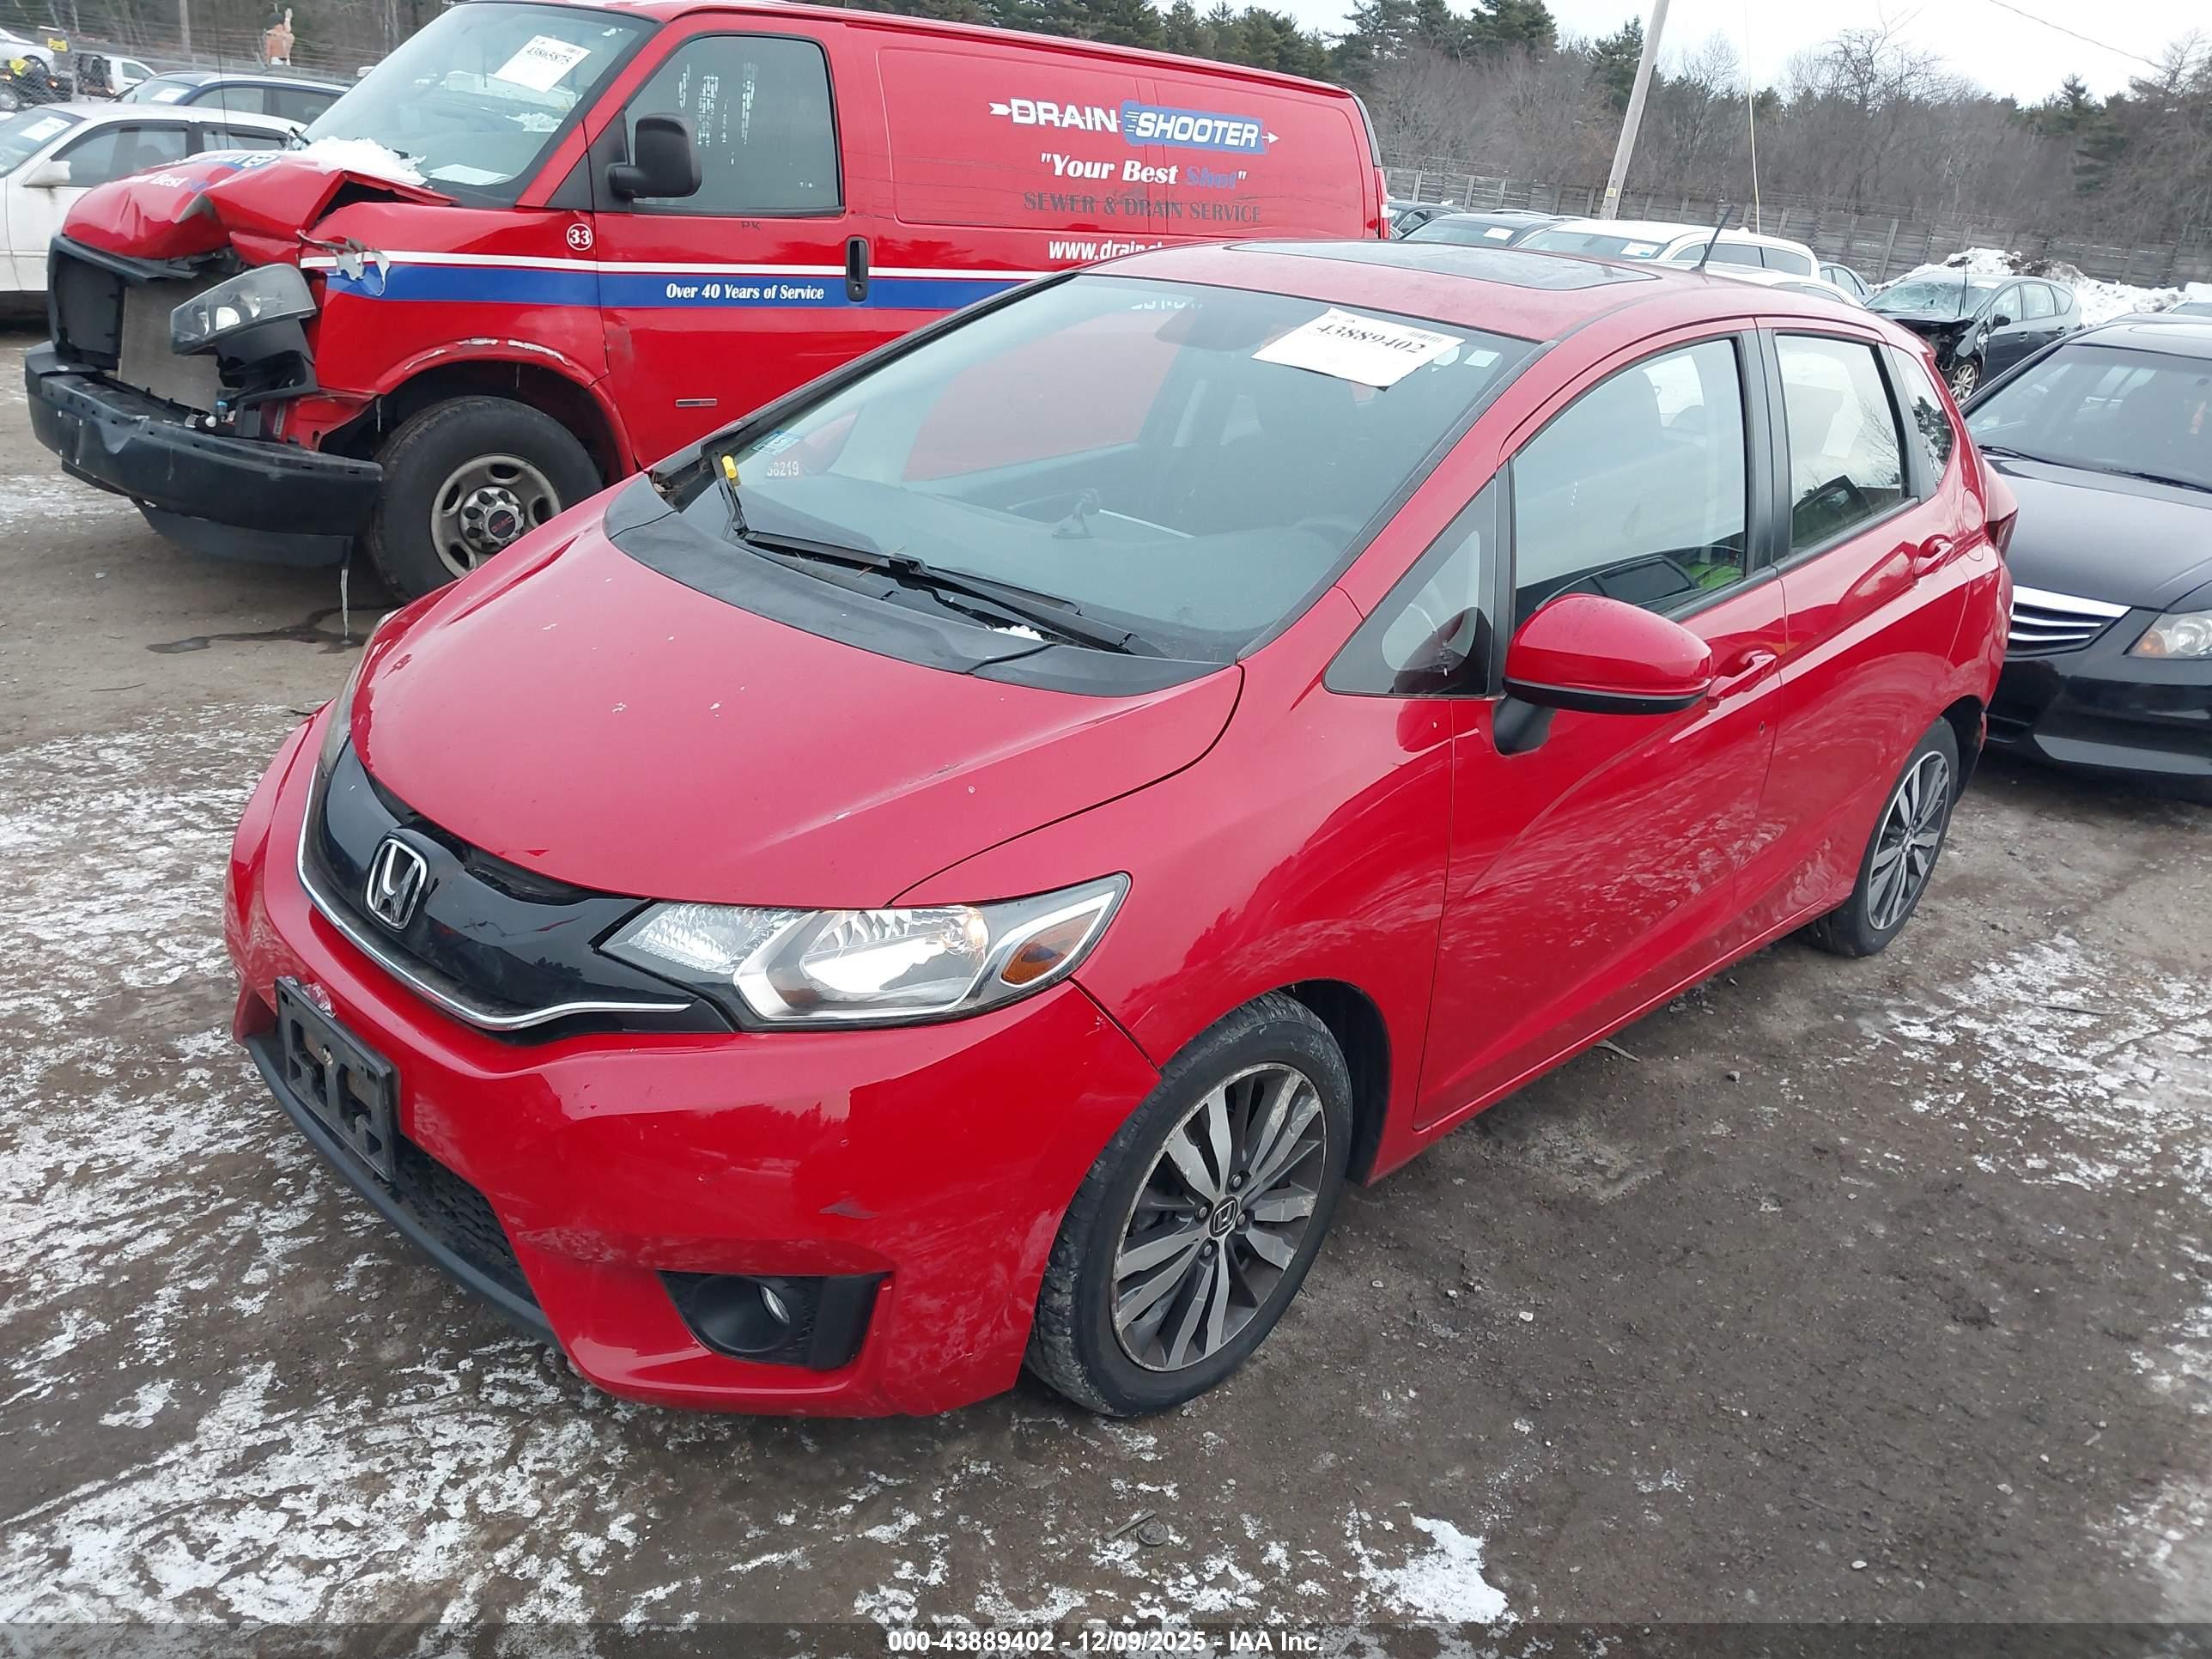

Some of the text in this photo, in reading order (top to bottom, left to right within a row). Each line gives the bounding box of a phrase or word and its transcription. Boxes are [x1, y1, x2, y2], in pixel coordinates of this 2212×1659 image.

[1010, 98, 1259, 148] DRAIN SHOOTER
[1040, 152, 1115, 179] "Your
[1121, 160, 1179, 185] Best
[1023, 191, 1262, 223] SEWER & DRAIN SERVICE
[569, 228, 591, 245] 33
[665, 283, 824, 300] Over 40 Years of Service
[1316, 323, 1426, 354] 43889402
